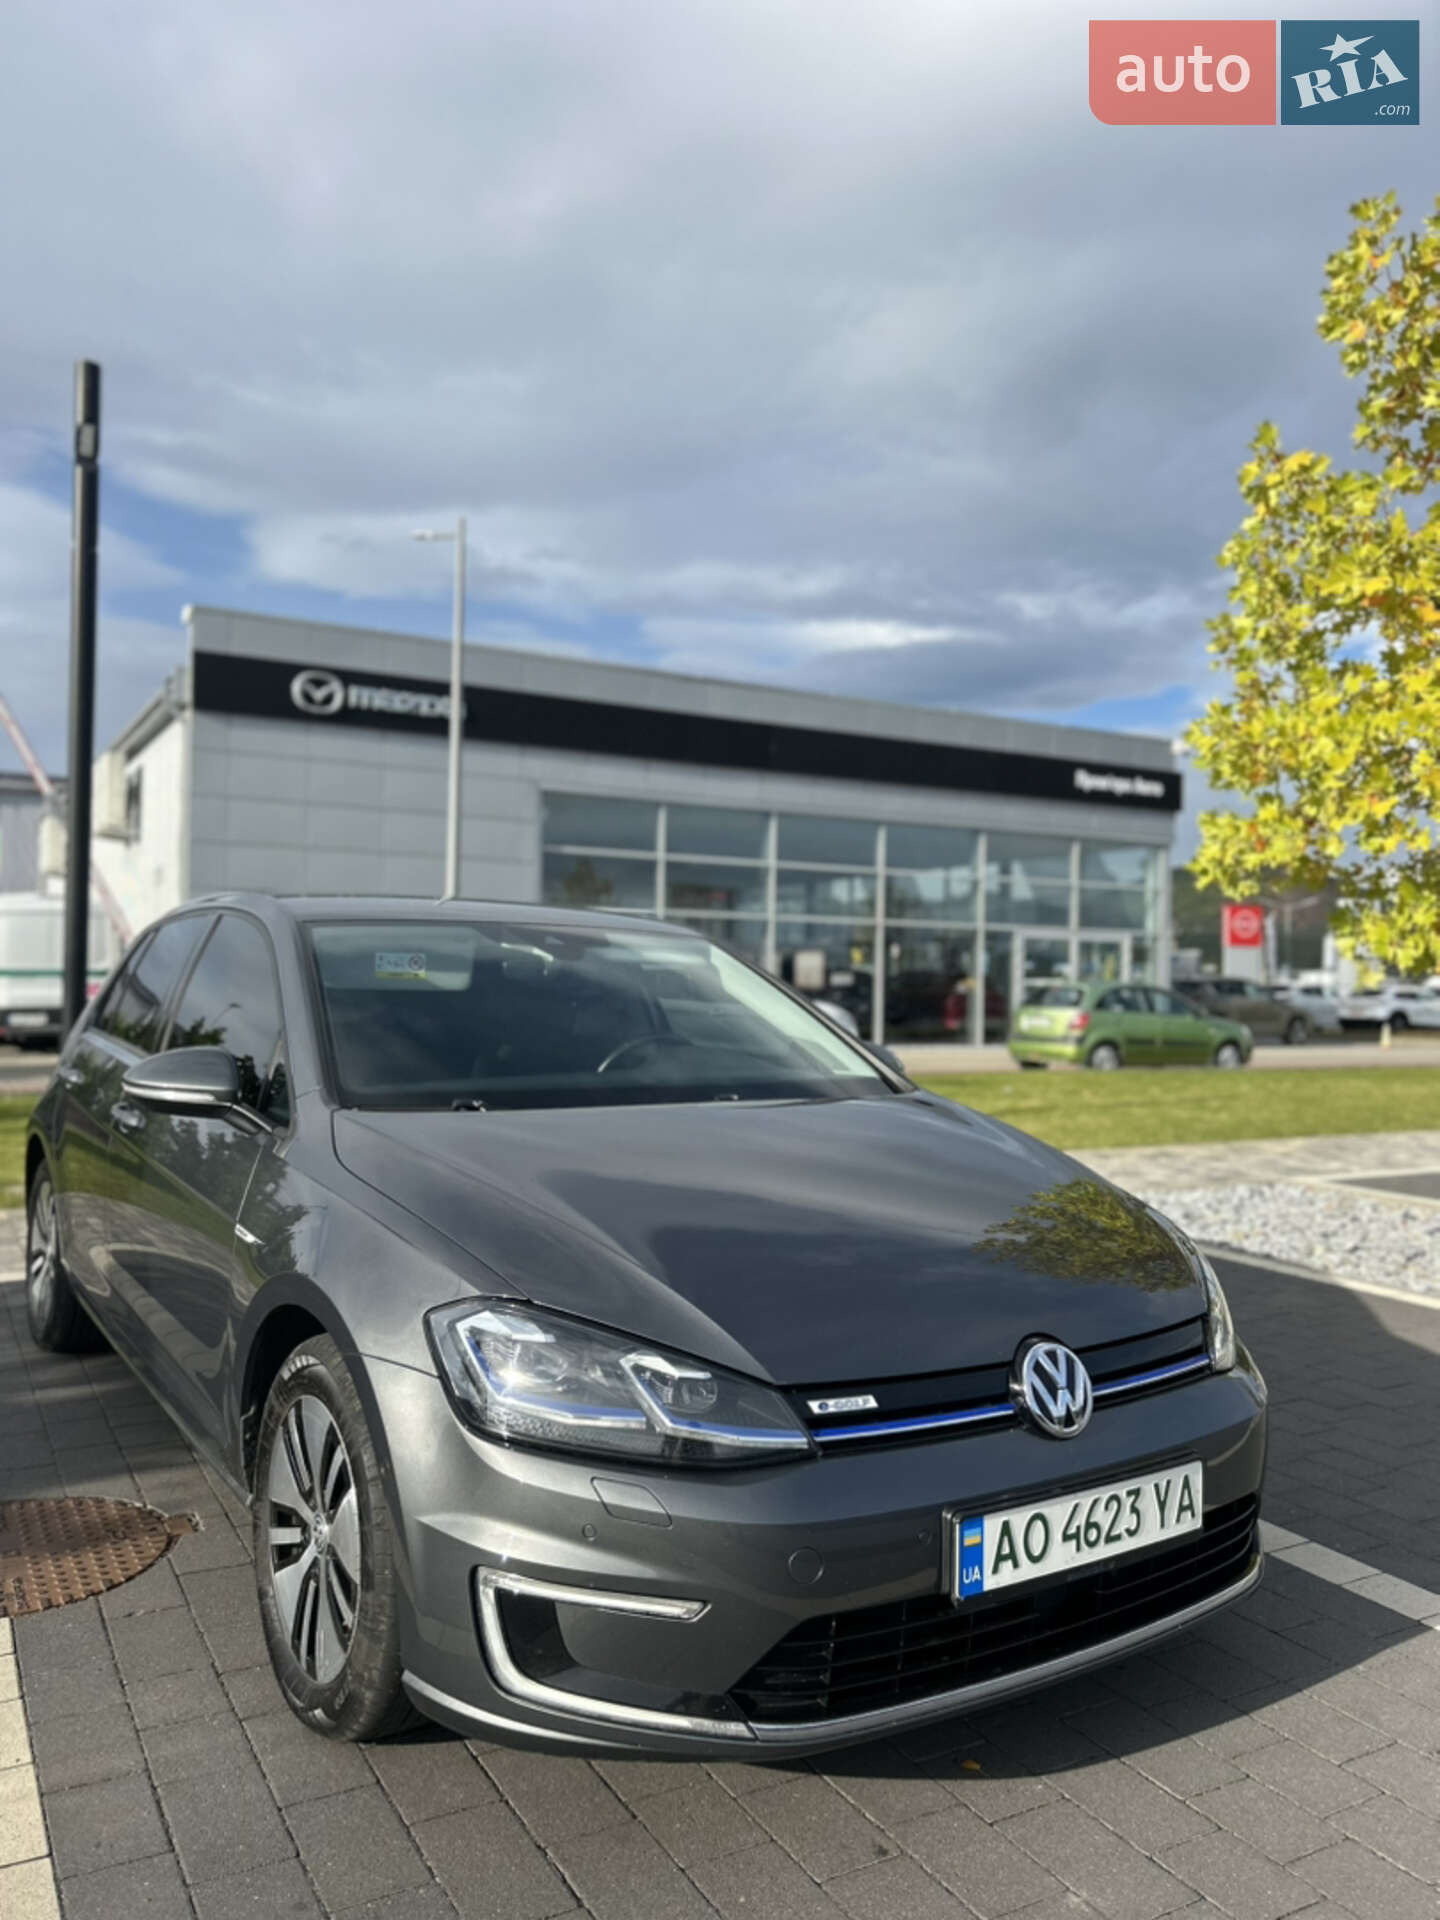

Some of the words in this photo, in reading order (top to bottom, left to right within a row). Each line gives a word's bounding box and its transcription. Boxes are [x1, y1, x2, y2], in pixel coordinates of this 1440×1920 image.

[991, 1511, 1049, 1575] AO
[1062, 1487, 1141, 1553] 4623
[1153, 1474, 1196, 1530] YA
[962, 1565, 982, 1584] UA
